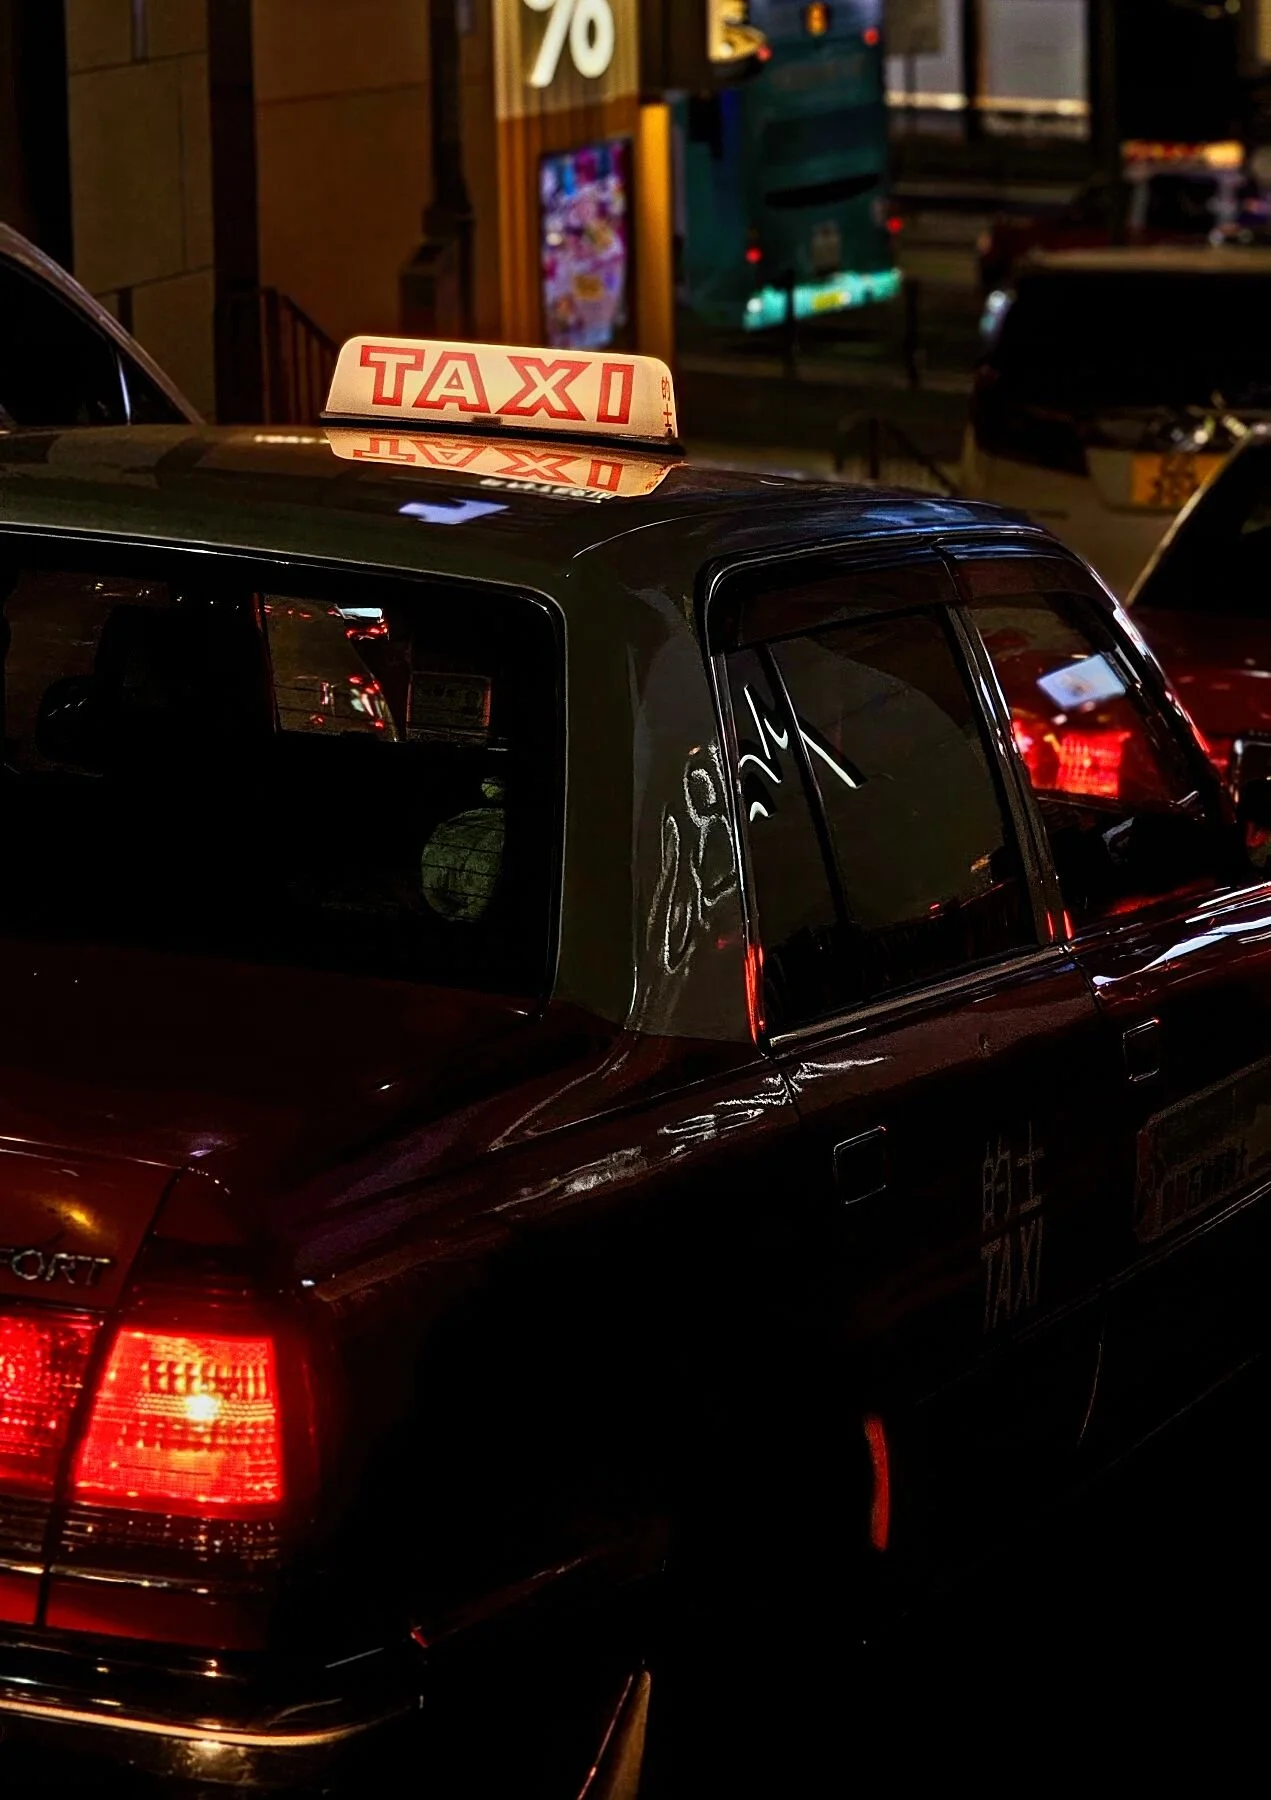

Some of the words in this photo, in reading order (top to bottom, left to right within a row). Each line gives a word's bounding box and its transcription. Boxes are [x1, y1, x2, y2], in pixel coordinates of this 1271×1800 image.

[360, 345, 635, 424] TAXI
[661, 376, 673, 428] 的士
[982, 1120, 1046, 1232] 的士
[980, 1213, 1046, 1336] TAXI
